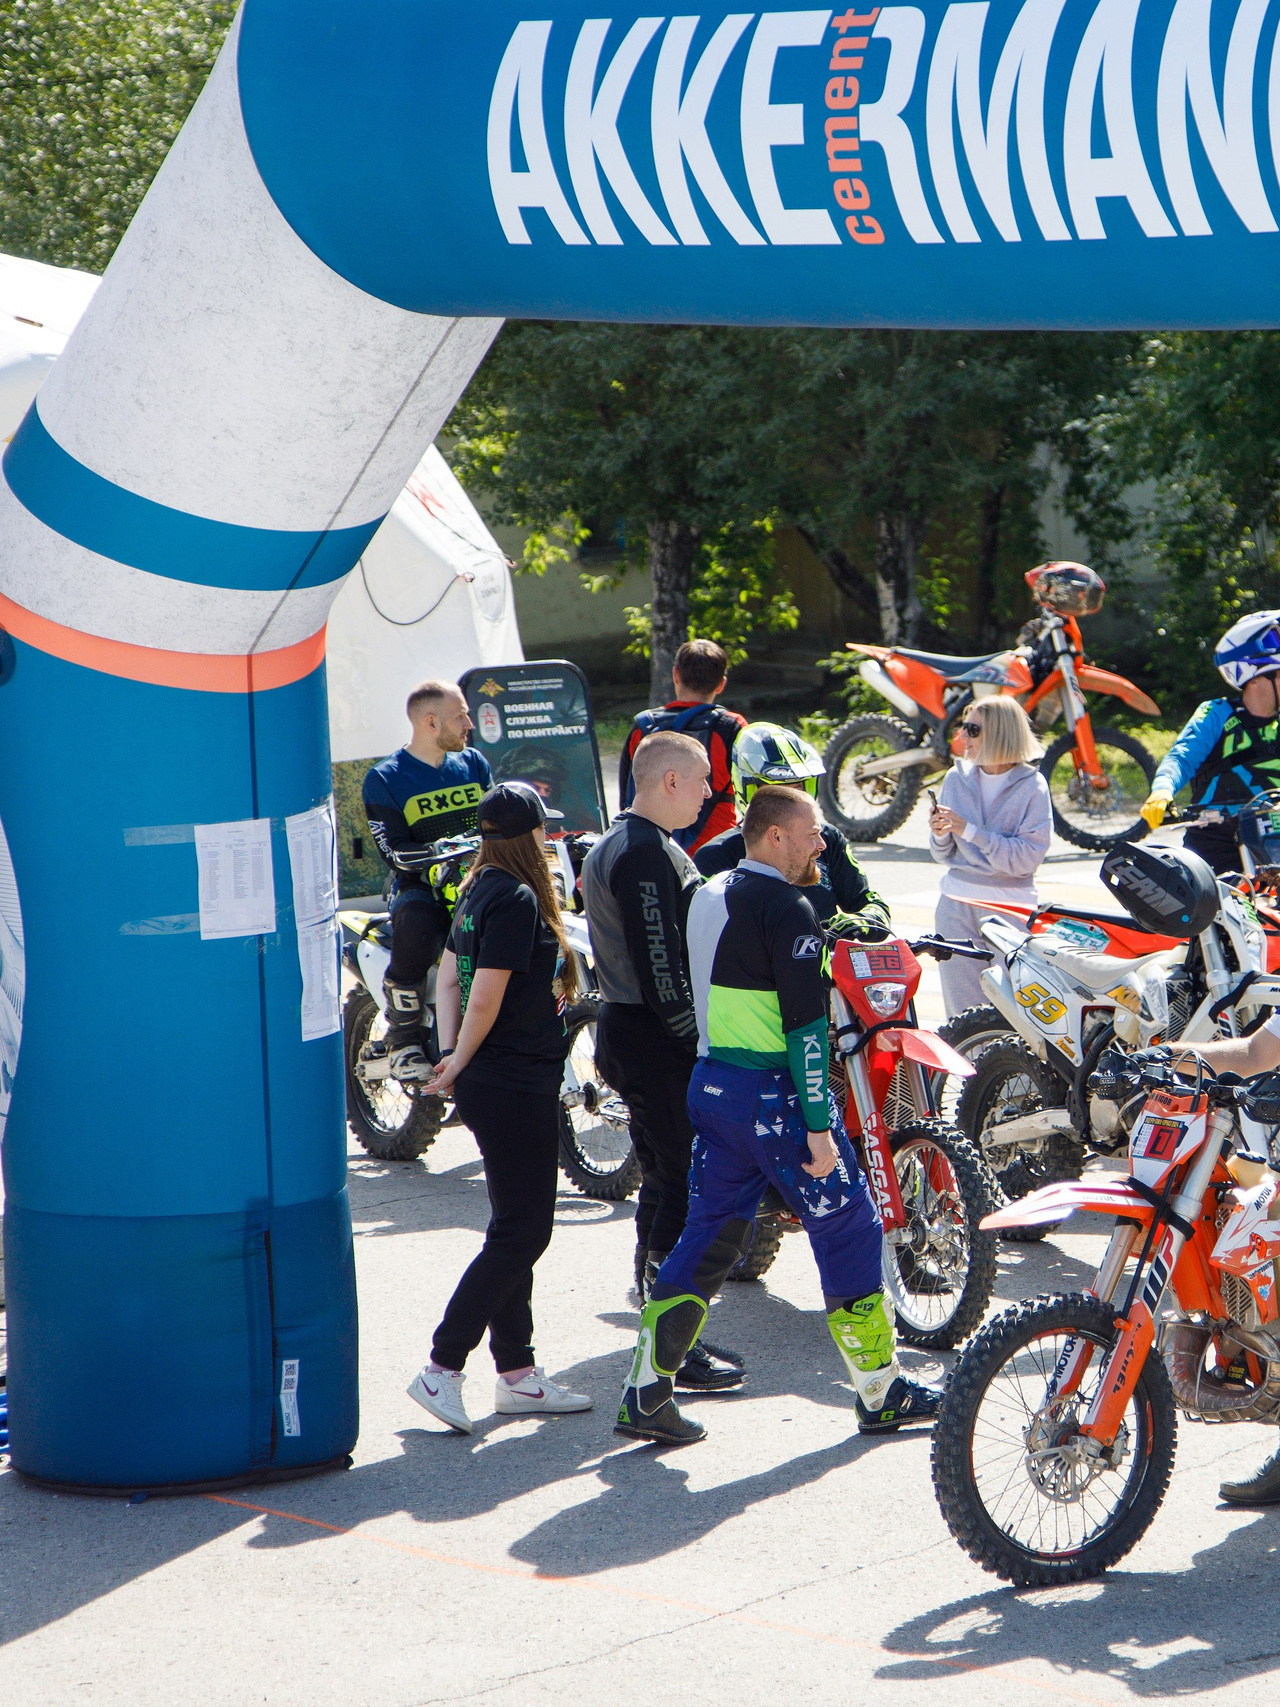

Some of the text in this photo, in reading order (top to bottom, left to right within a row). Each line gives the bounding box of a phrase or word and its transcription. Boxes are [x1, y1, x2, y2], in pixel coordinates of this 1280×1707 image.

[825, 7, 881, 245] cement
[504, 701, 555, 713] ВОЕННАЯ
[506, 714, 552, 726] СЛУЖБА
[507, 725, 586, 739] ПО КОНТРАКТУ
[639, 881, 678, 1003] FASTHOUSE
[869, 955, 901, 970] 36
[1014, 981, 1068, 1025] 59
[803, 1033, 824, 1102] KLIM
[703, 1085, 724, 1097] LEATT
[1254, 1186, 1272, 1211] MOTUL
[841, 1335, 862, 1348] G
